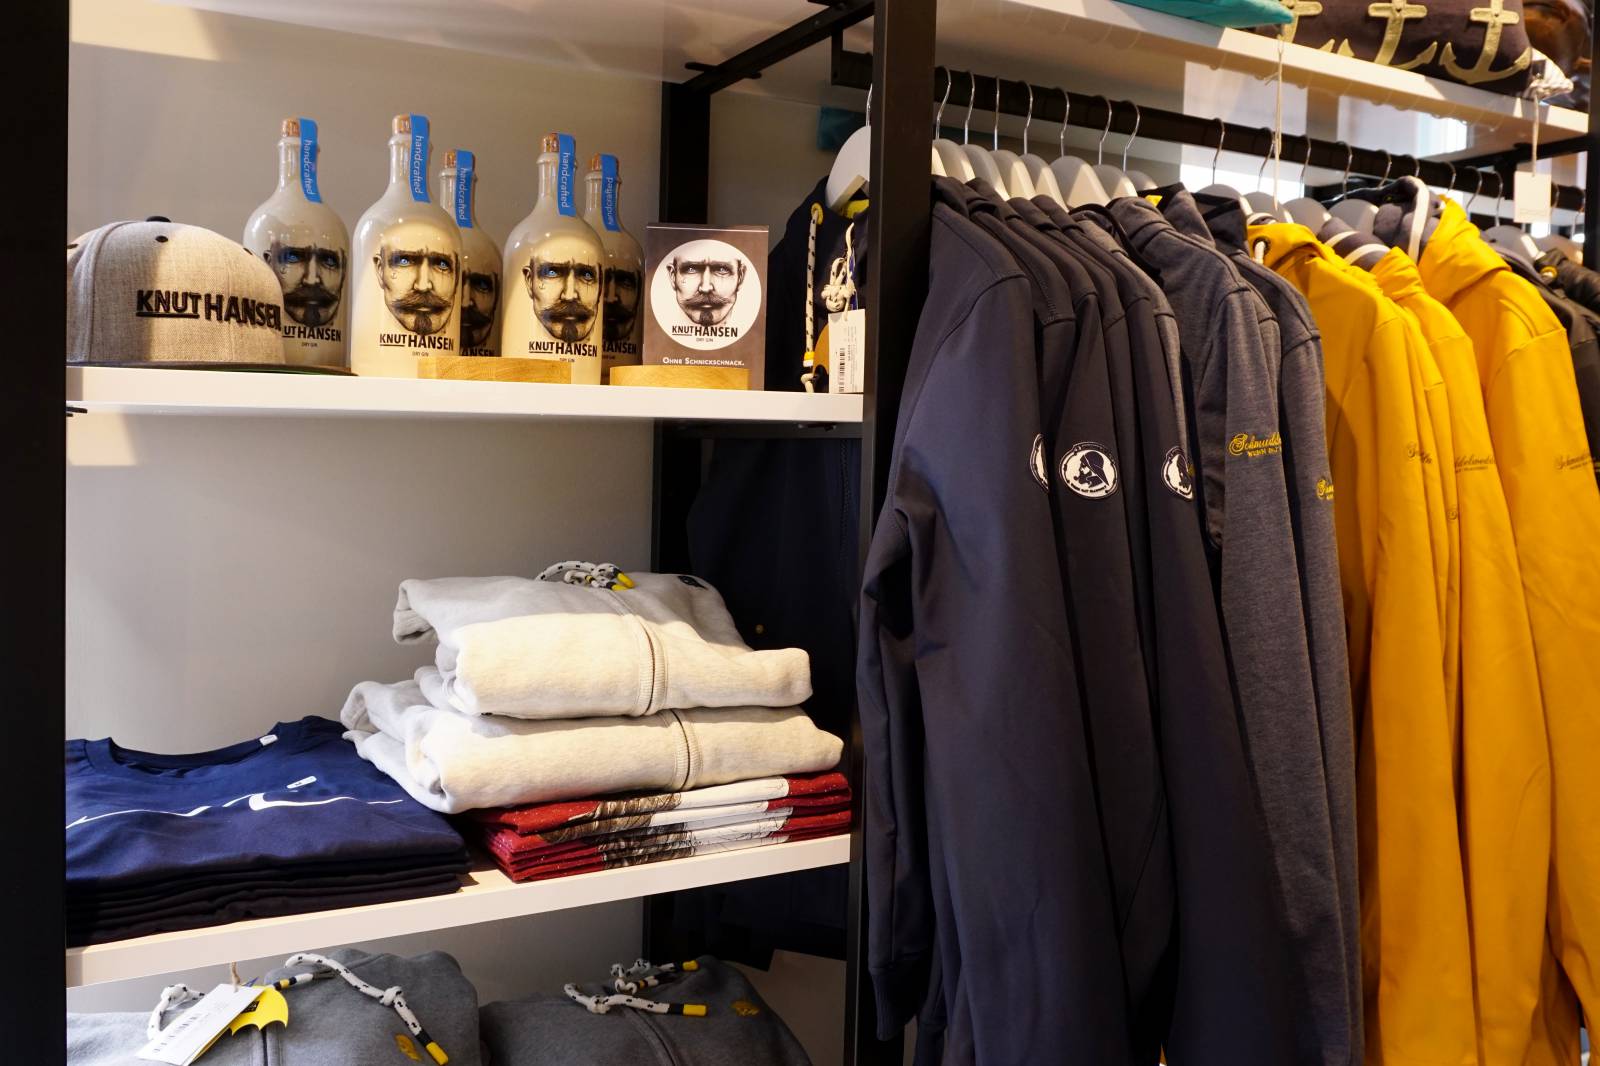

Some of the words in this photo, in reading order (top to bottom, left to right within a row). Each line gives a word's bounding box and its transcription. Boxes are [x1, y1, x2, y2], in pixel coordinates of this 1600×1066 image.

[304, 138, 318, 195] handcrafted
[413, 135, 425, 194] handcrafted
[561, 152, 571, 208] handcrafted
[458, 167, 469, 221] handcrafted
